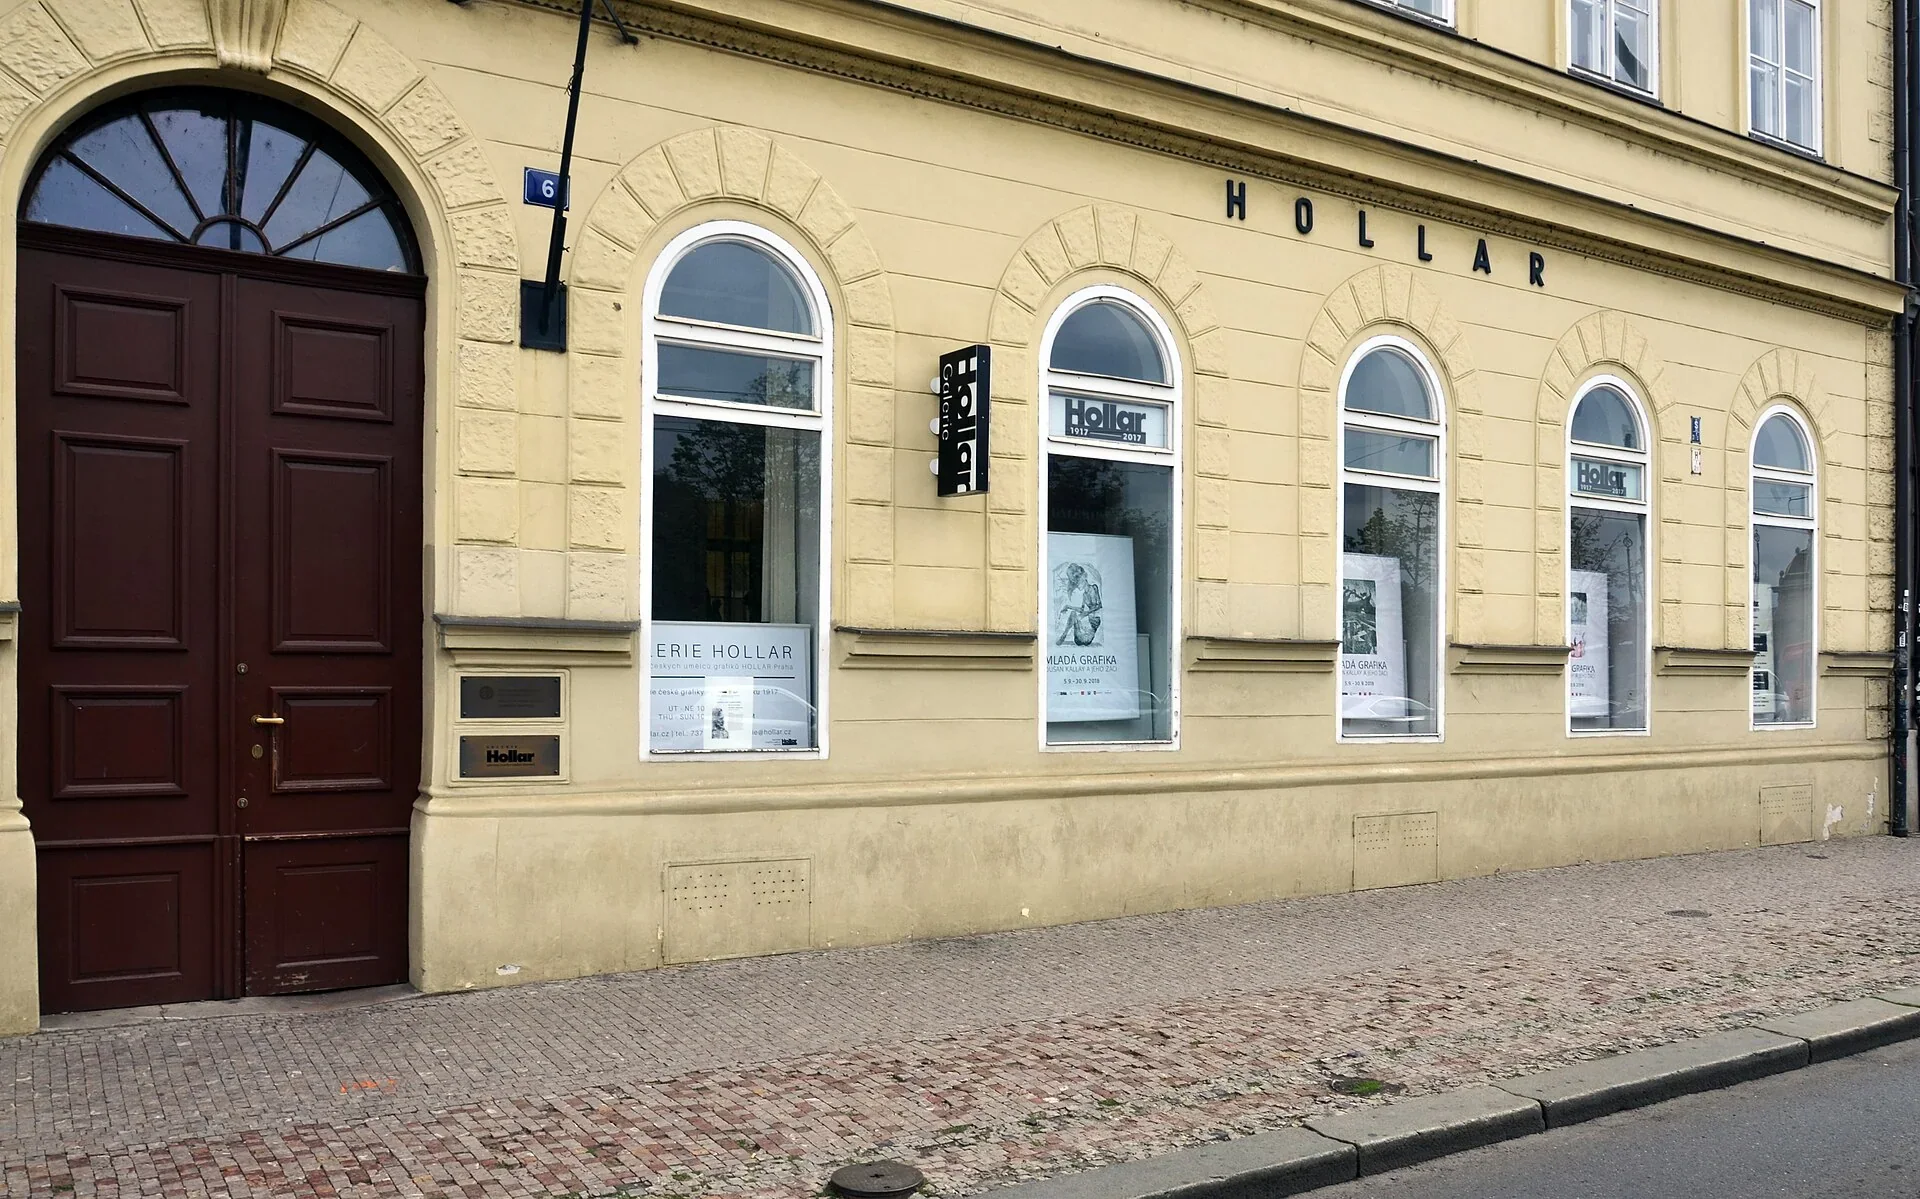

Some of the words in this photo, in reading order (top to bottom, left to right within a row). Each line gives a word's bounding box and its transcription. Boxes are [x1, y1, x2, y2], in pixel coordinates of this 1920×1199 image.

[541, 179, 554, 198] 6
[1226, 179, 1545, 287] HOLLAR
[942, 363, 953, 441] Galerie
[957, 354, 976, 493] Hollar
[1065, 398, 1147, 433] Hollar
[1070, 426, 1089, 436] 1917
[1122, 432, 1141, 442] 2017
[1578, 462, 1627, 490] Hollar
[651, 643, 702, 659] ERIE
[712, 644, 792, 659] HOLLAR
[1080, 655, 1117, 665] GRAFIKA
[773, 663, 794, 671] Praha
[486, 749, 535, 763] Hollar
